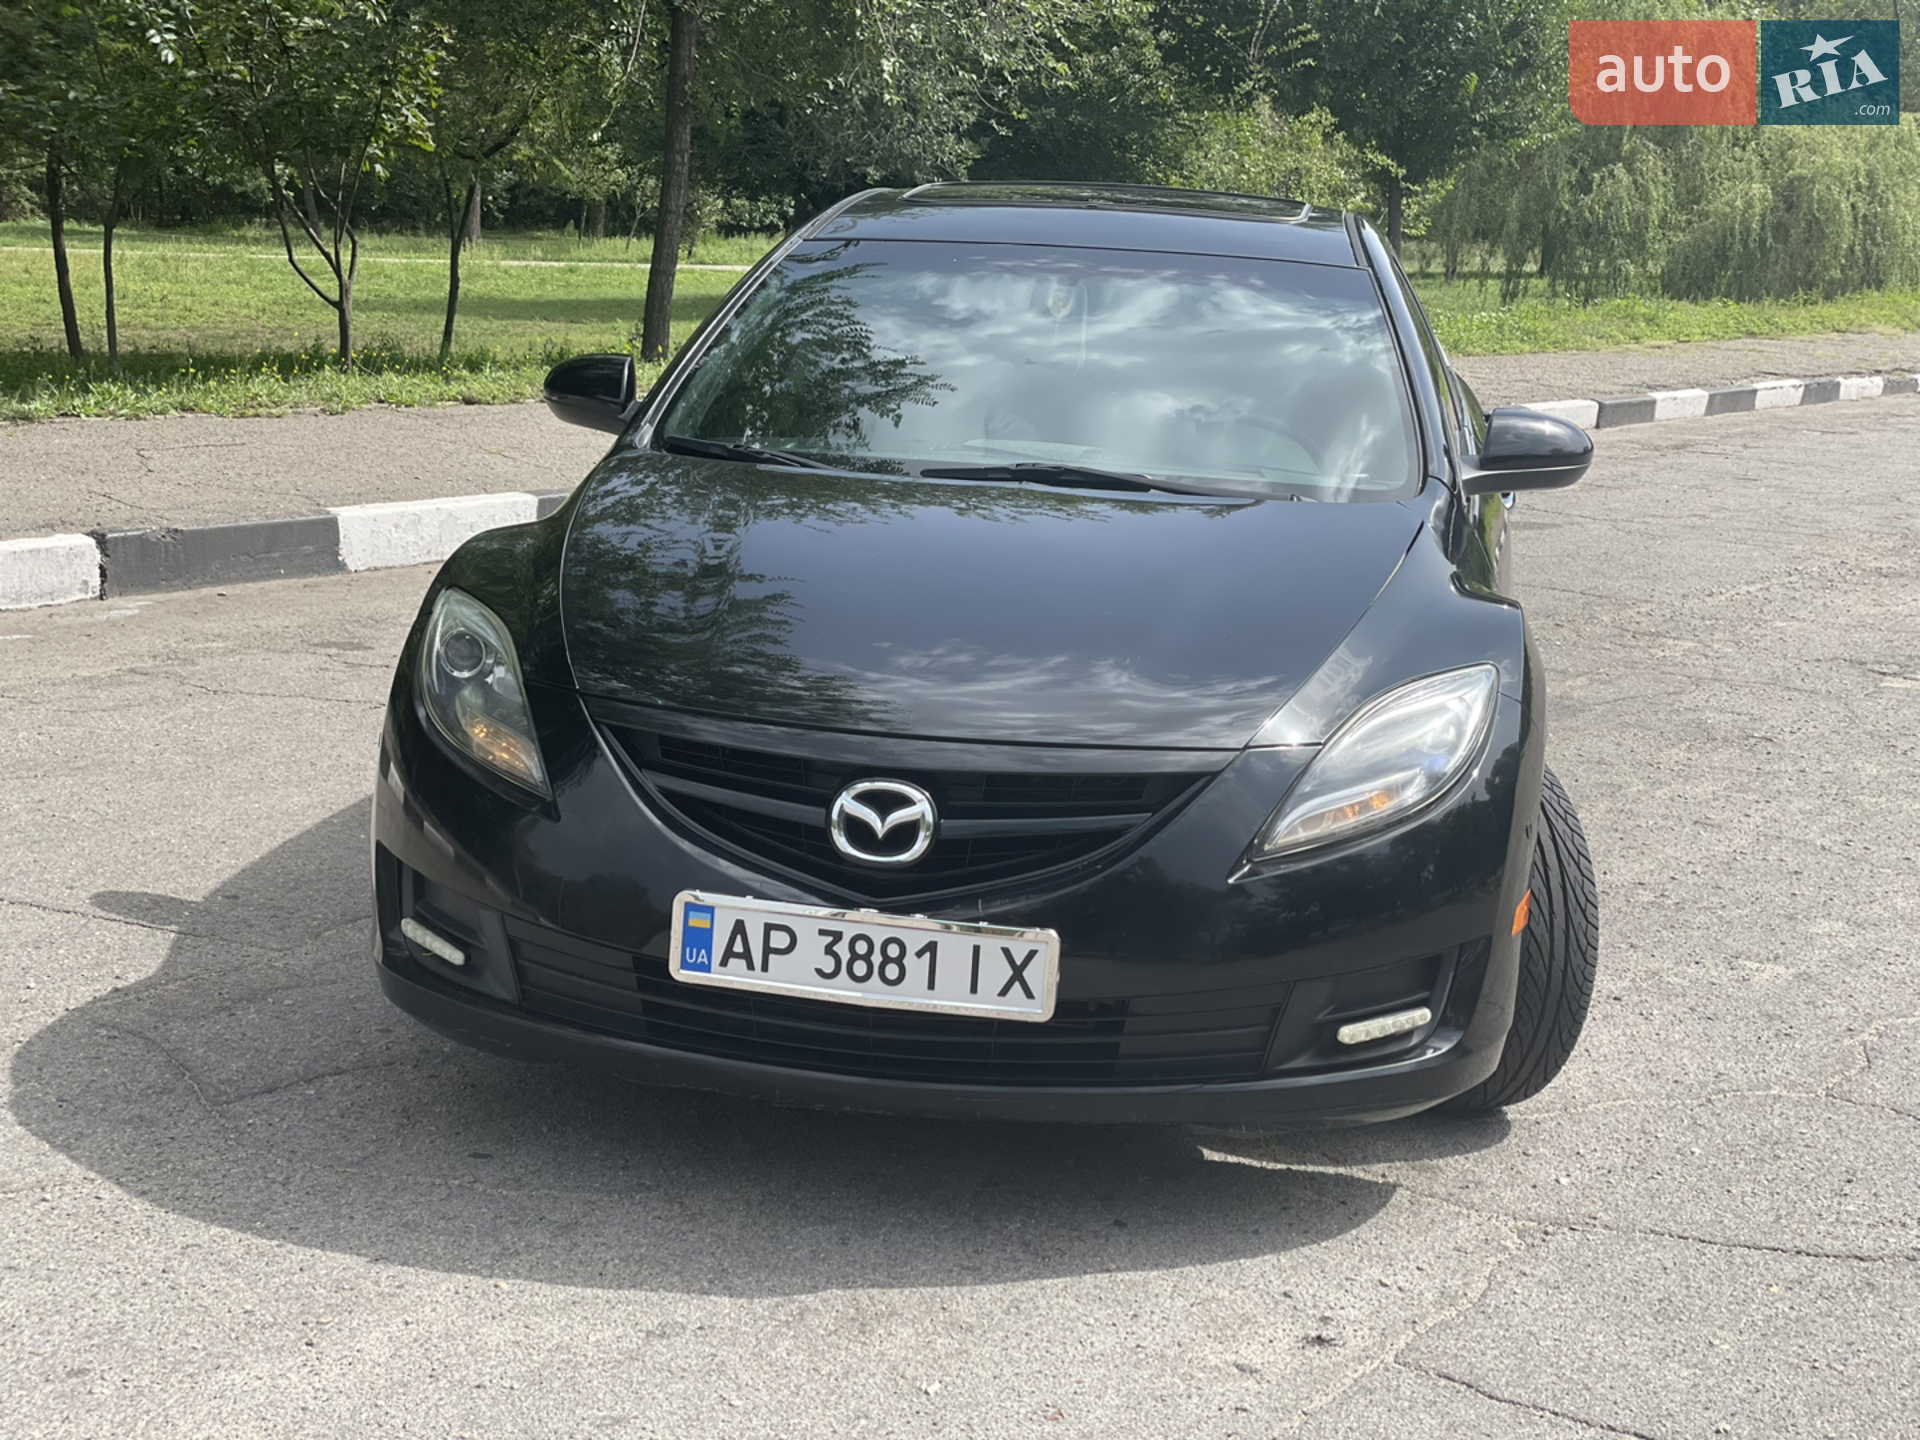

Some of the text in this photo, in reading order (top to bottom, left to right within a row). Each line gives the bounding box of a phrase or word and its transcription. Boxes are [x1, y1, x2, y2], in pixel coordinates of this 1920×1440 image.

[686, 946, 709, 965] UA
[718, 918, 1039, 1000] AP 3881 IX
